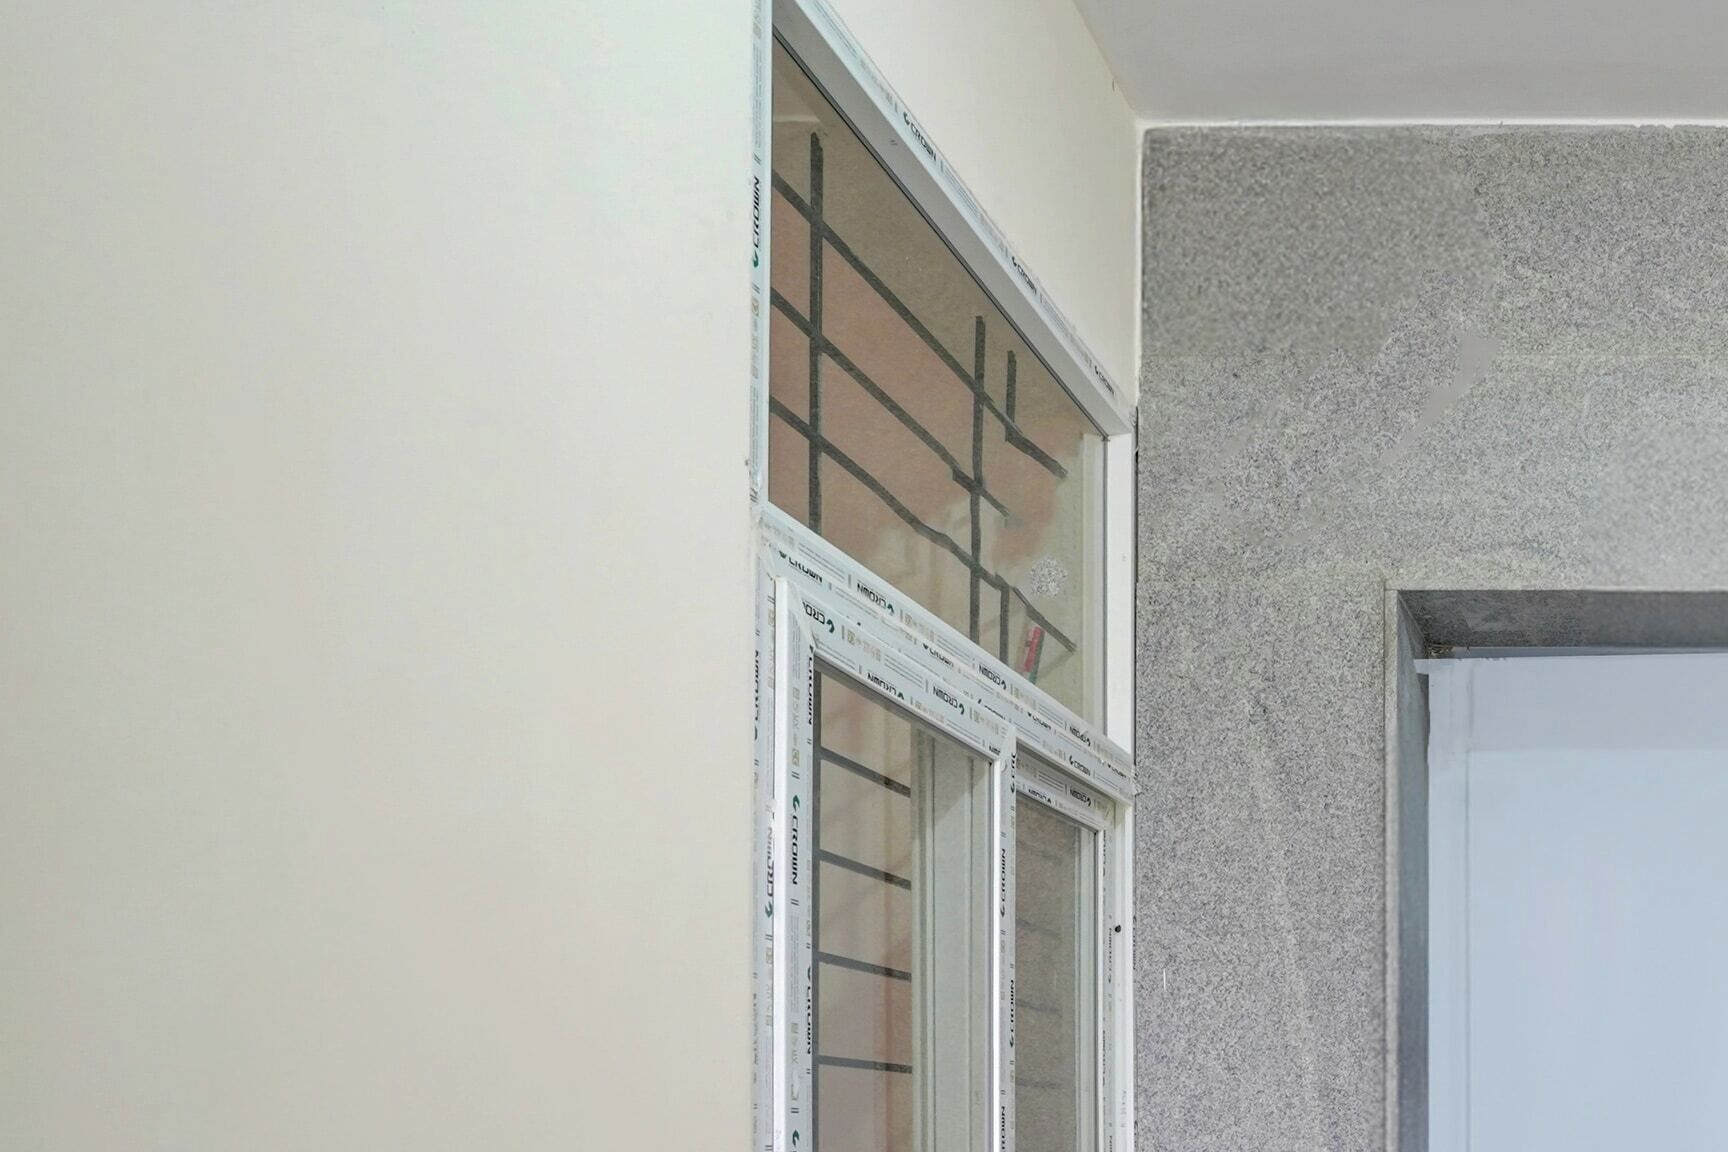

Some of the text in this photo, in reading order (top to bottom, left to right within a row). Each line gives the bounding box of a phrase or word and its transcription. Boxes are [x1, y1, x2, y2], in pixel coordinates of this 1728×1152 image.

[857, 582, 887, 609] CROWN
[802, 600, 826, 625] CRO
[978, 664, 1001, 686] CROWN
[933, 686, 958, 709] CROWN
[791, 815, 799, 885] CROWN
